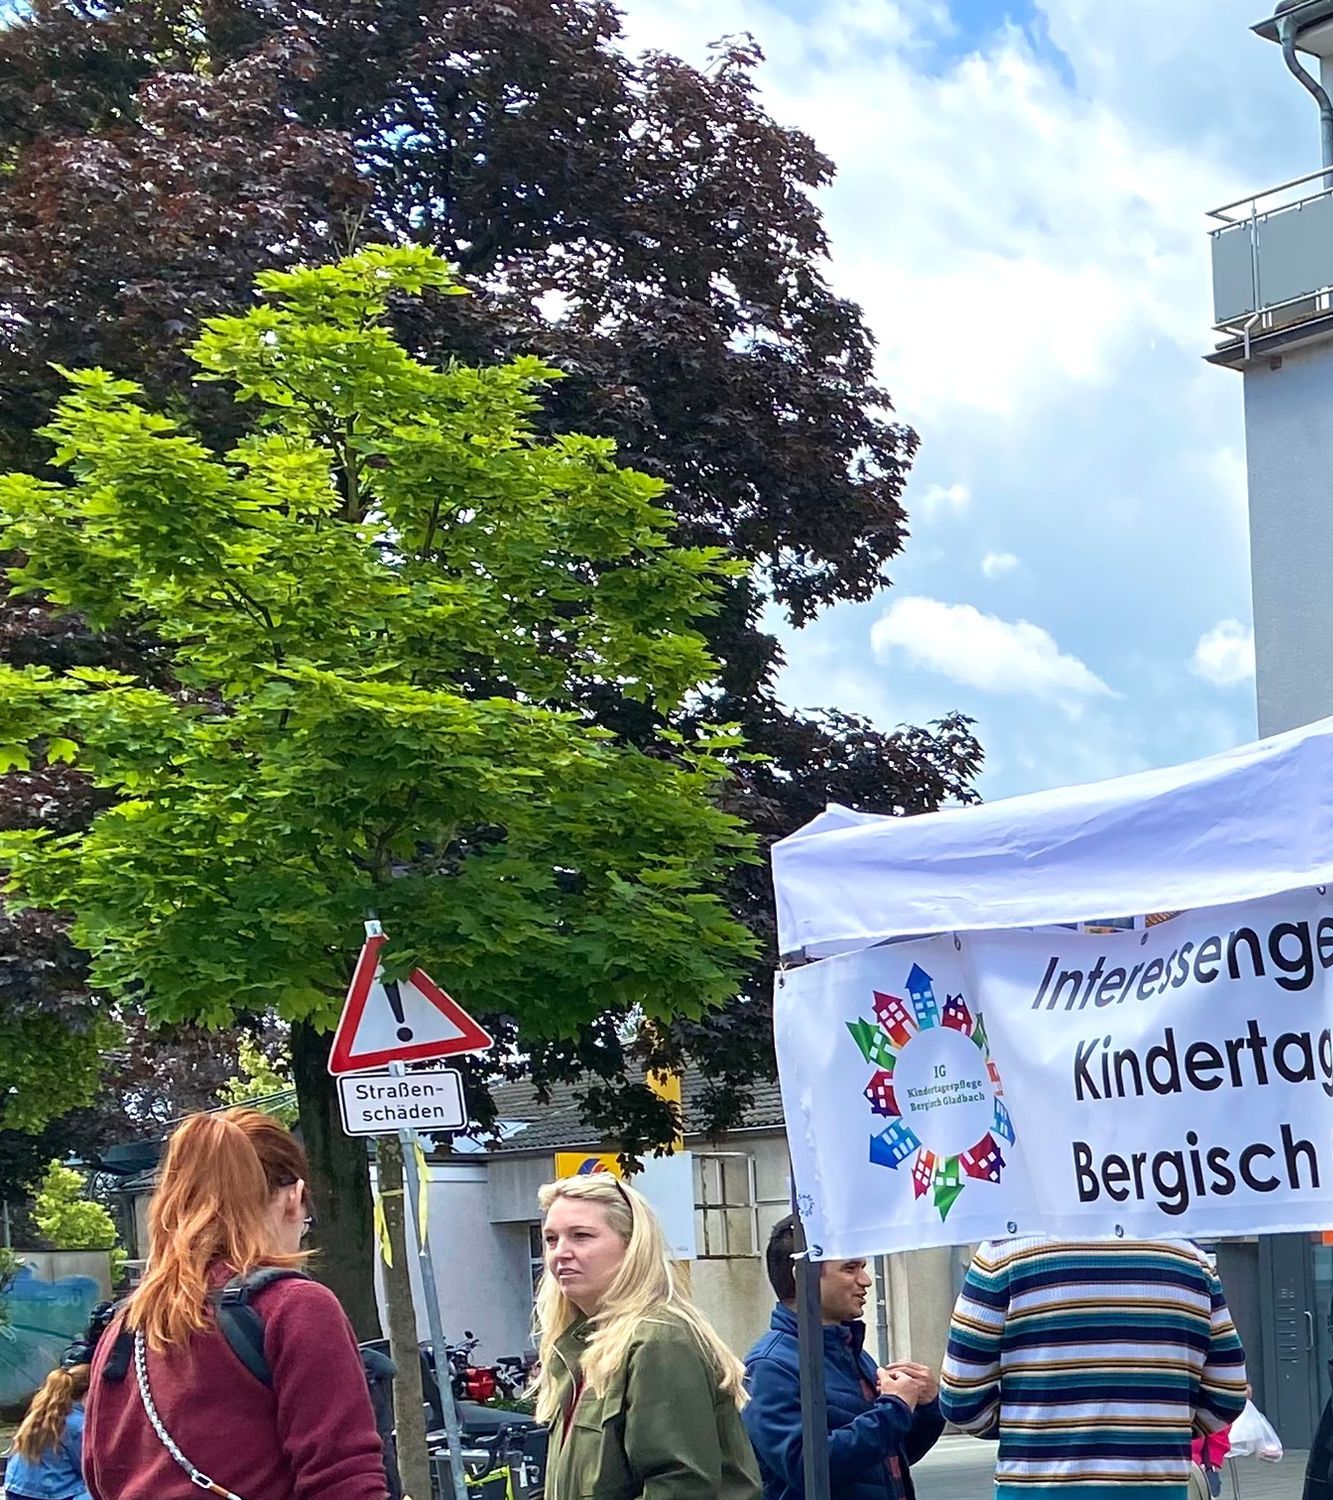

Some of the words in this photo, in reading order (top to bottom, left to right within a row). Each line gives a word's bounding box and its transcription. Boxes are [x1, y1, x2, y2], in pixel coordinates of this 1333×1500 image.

[933, 1064, 947, 1079] IG
[356, 1082, 444, 1100] Straßen-
[907, 1079, 983, 1098] Kindertagespflege
[909, 1097, 942, 1111] Bergisch
[943, 1092, 985, 1106] Gladbach
[362, 1103, 445, 1122] schäden
[1072, 1123, 1321, 1215] Bergisch
